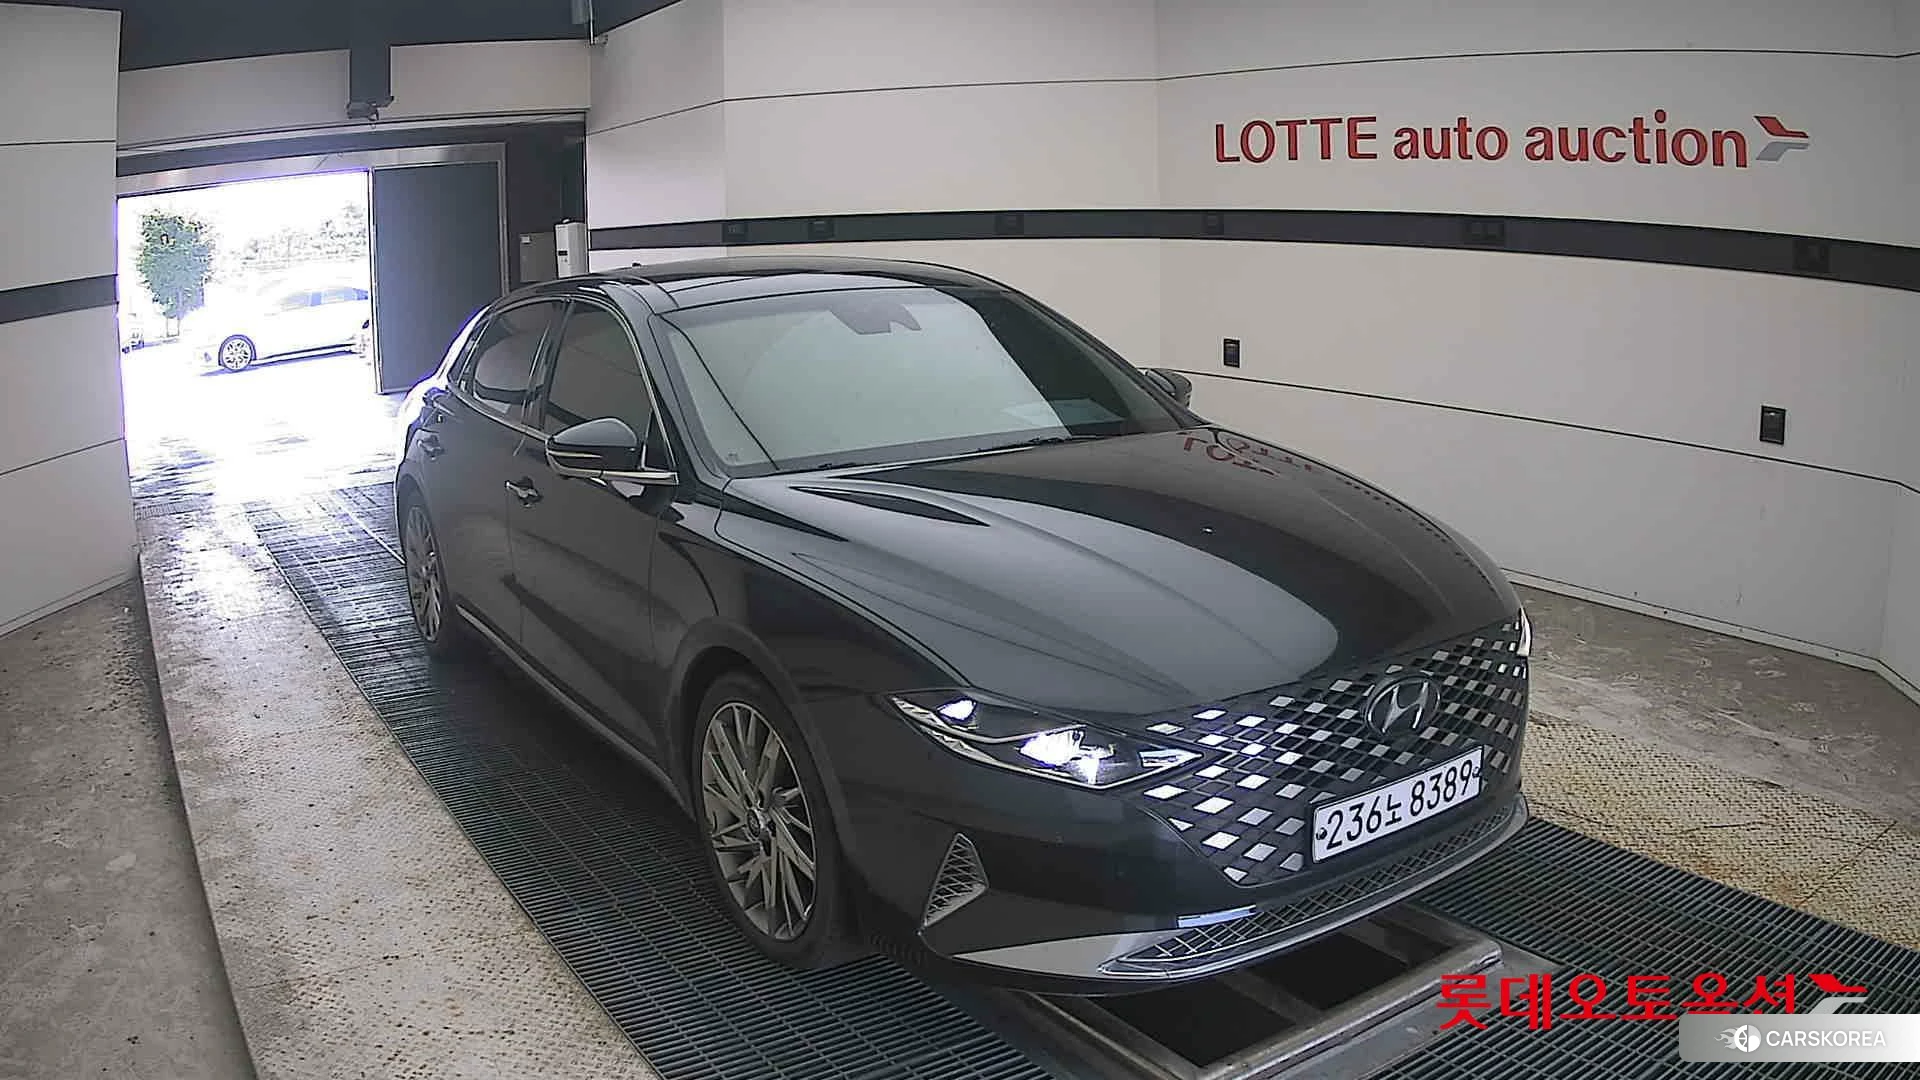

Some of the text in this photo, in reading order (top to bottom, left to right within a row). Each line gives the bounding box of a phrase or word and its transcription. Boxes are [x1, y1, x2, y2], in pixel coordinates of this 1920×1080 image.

[1214, 109, 1749, 168] LOTTE auto auction
[1326, 759, 1474, 850] 236노 8389
